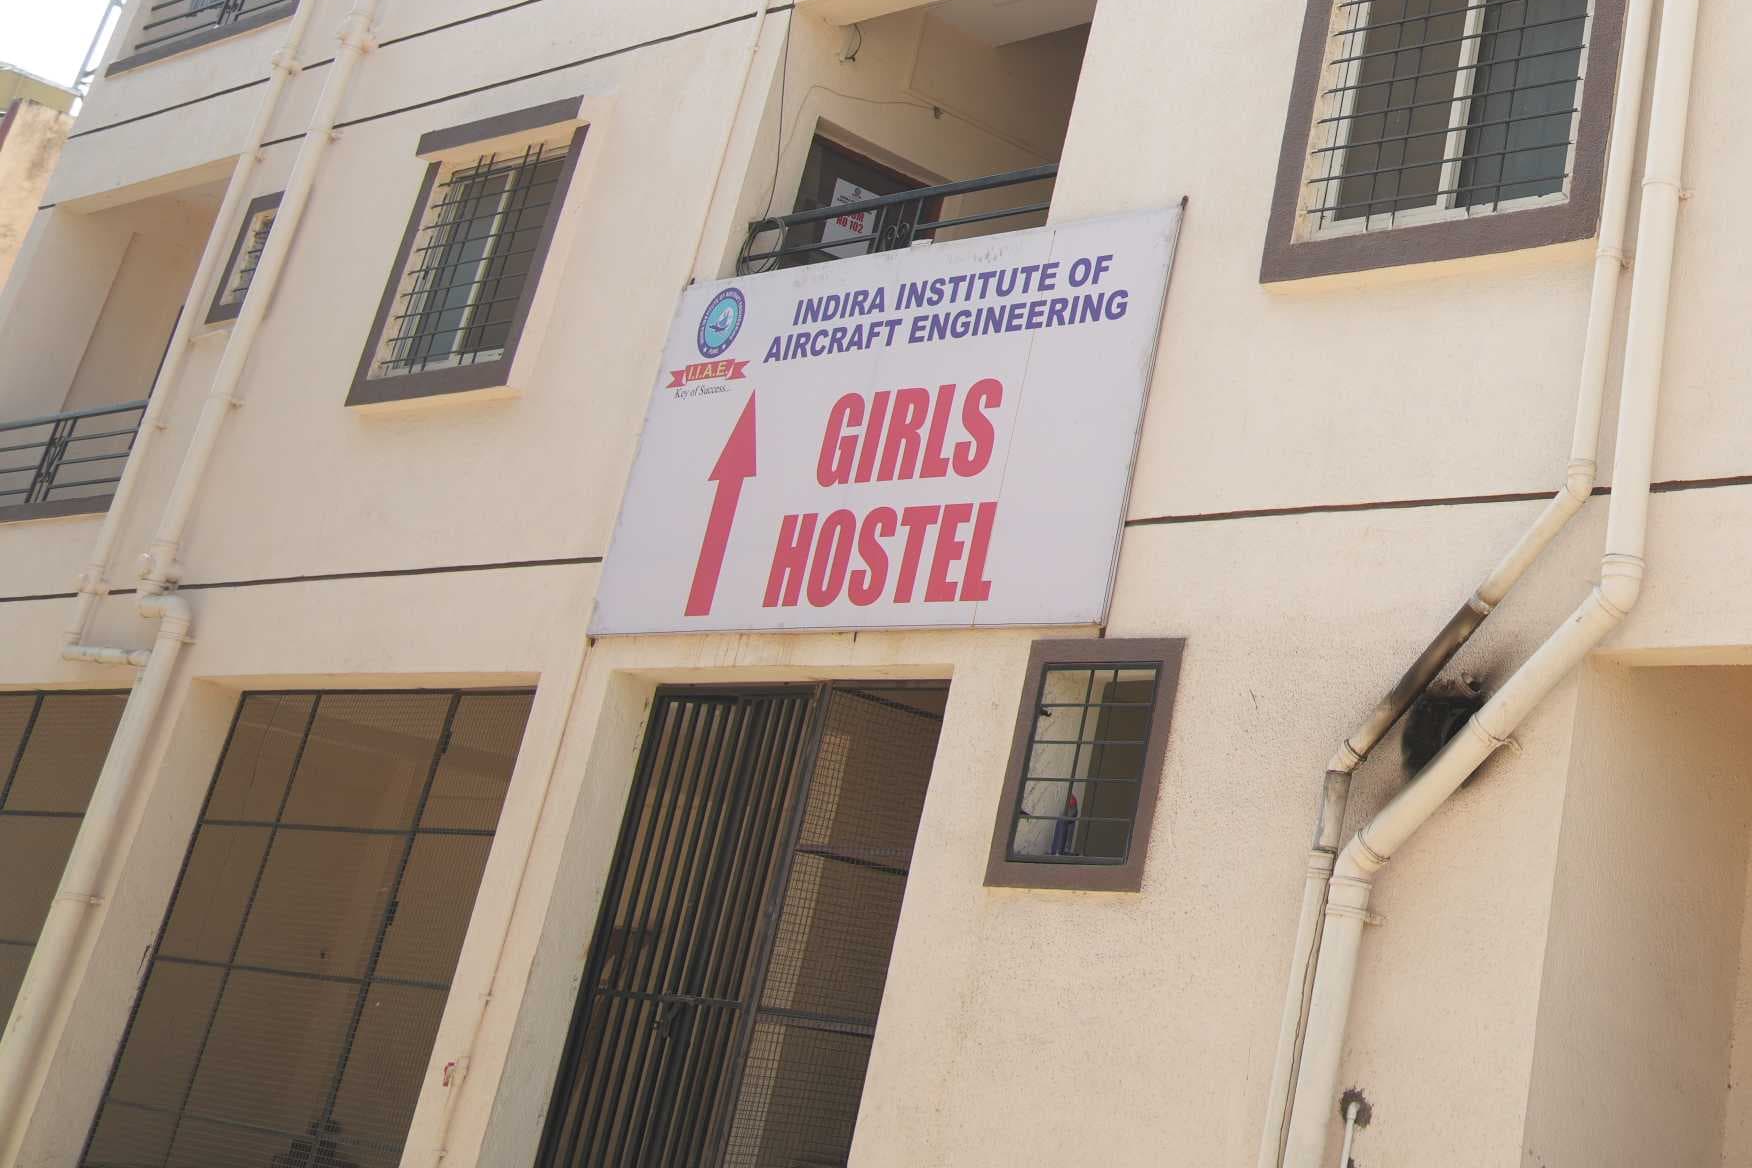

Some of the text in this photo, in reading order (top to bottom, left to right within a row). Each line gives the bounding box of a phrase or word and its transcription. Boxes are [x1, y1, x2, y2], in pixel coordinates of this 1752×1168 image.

[849, 220, 864, 234] 102
[763, 289, 1129, 363] AIRCRAFT ENGINEERING
[793, 254, 1114, 326] INDIRA INSTITUTE OF
[674, 388, 688, 400] Key
[816, 378, 1003, 487] GIRLS
[762, 501, 998, 608] HOSTEL
